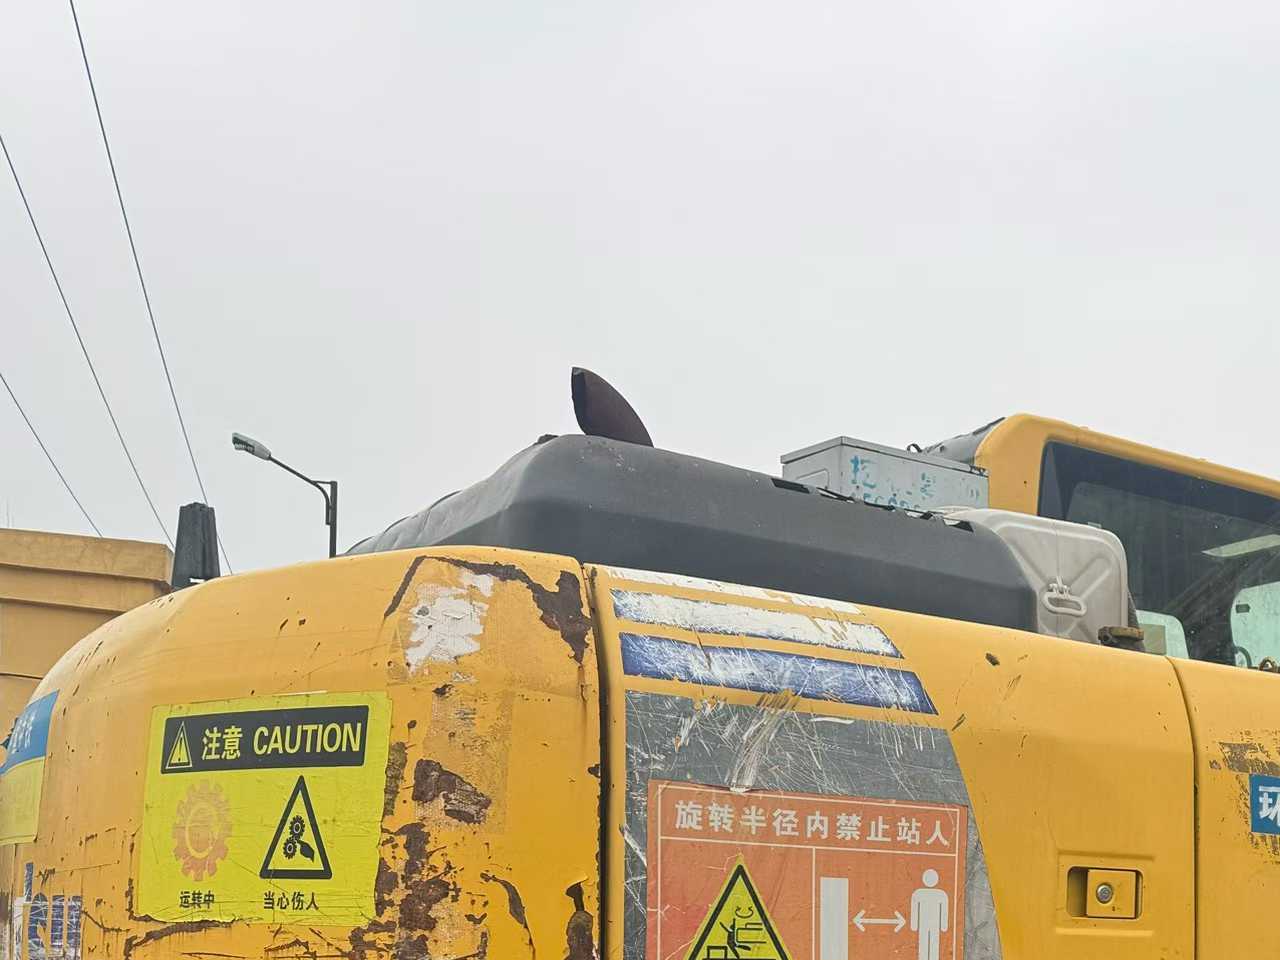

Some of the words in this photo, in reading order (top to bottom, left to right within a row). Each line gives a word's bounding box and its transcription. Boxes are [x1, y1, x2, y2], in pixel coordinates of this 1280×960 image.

[202, 725, 243, 760] 注意
[253, 722, 362, 755] CAUTION
[675, 800, 950, 846] 旋转半径内禁止站人
[179, 890, 215, 910] 运转中
[263, 891, 320, 911] 当心伤人
